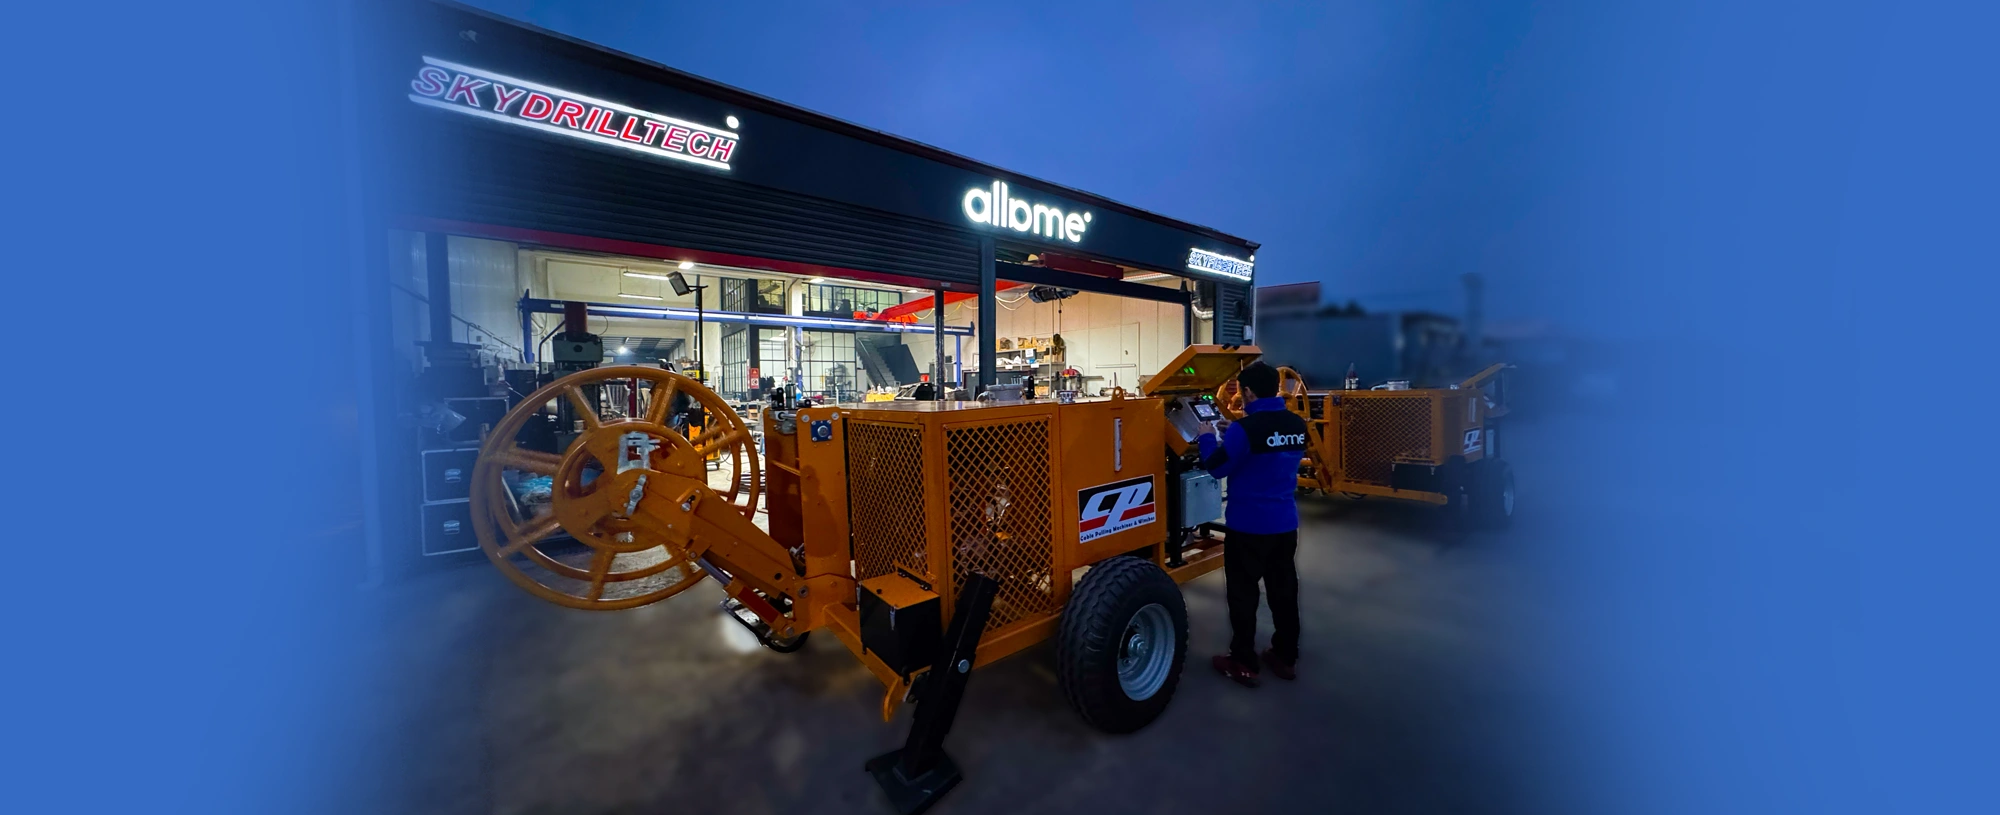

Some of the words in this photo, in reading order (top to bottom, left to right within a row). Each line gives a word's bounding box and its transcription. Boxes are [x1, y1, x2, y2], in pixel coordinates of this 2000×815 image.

[411, 65, 737, 162] SKYDRILLTECH
[1080, 533, 1094, 541] Cable
[1095, 528, 1112, 537] Pulling
